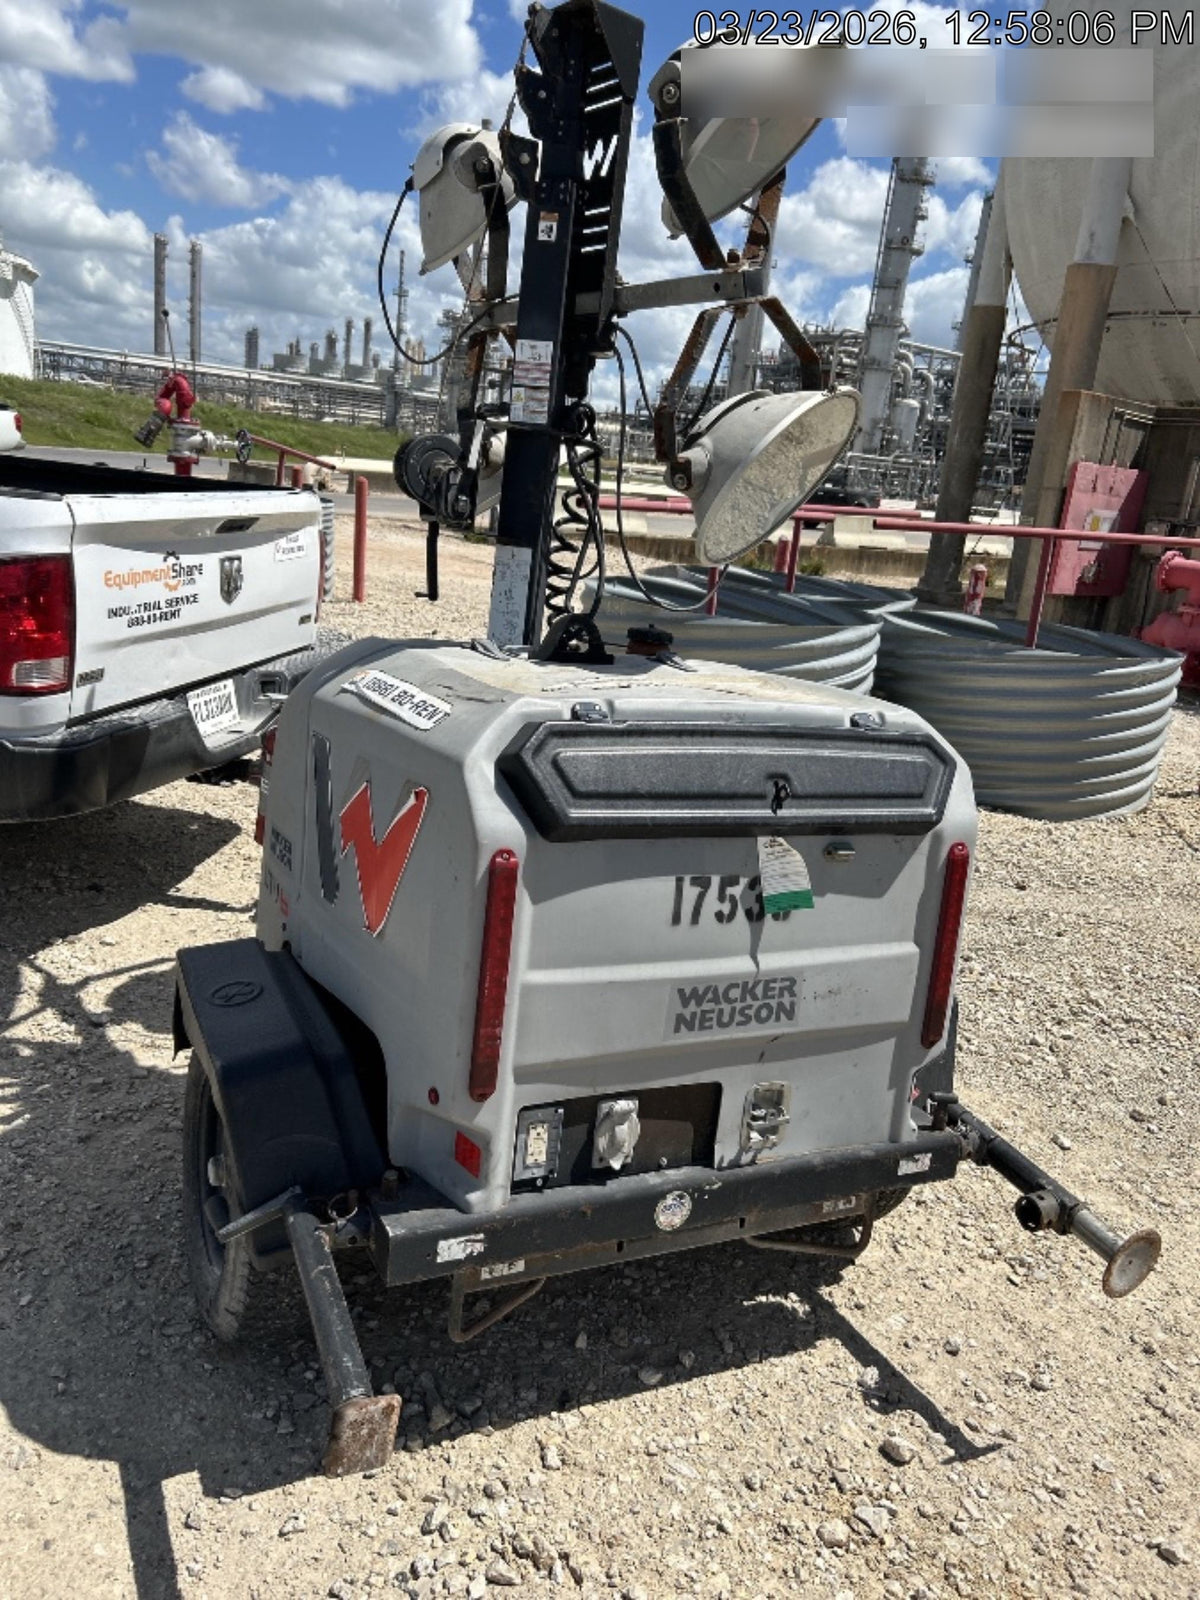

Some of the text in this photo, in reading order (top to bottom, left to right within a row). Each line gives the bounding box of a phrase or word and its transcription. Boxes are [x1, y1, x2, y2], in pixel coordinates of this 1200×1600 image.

[104, 562, 204, 590] EquipmentShare
[671, 874, 792, 926] 1753
[677, 976, 797, 1009] WACKER
[673, 1000, 796, 1034] NEUSON
